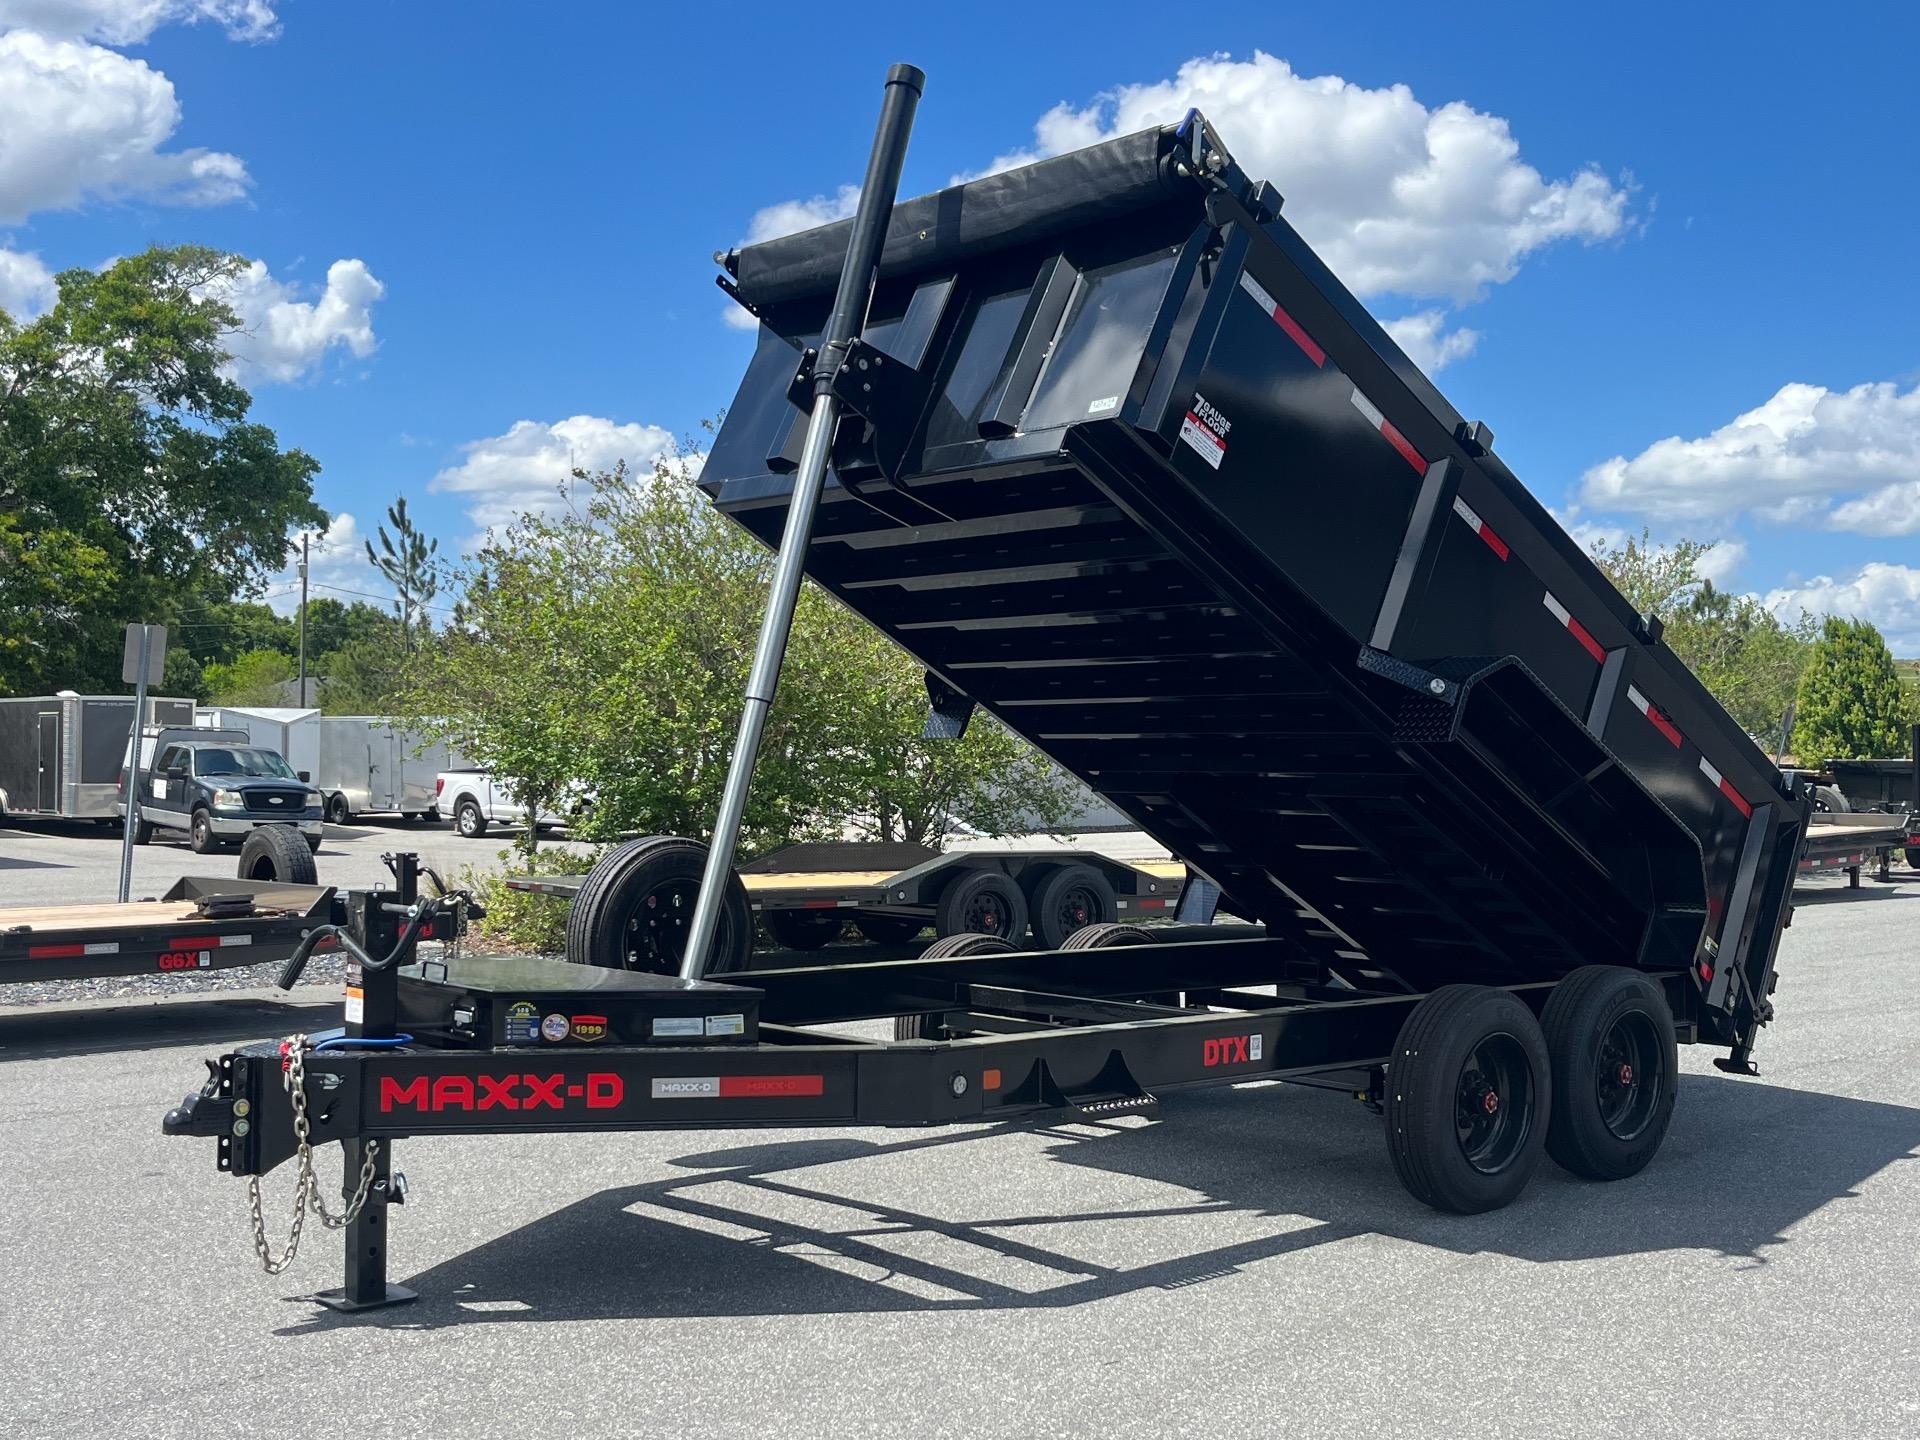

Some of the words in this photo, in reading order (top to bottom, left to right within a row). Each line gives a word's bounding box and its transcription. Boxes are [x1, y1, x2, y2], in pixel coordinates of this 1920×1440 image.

[1193, 392, 1205, 414] 7
[1203, 401, 1231, 432] GAUGE
[1198, 408, 1226, 438] FLOOR
[159, 952, 198, 970] G6X
[575, 1025, 602, 1034] 1999
[1204, 1035, 1248, 1067] DTX
[380, 1073, 624, 1112] MAXX-D
[661, 1083, 712, 1092] MAXX-D
